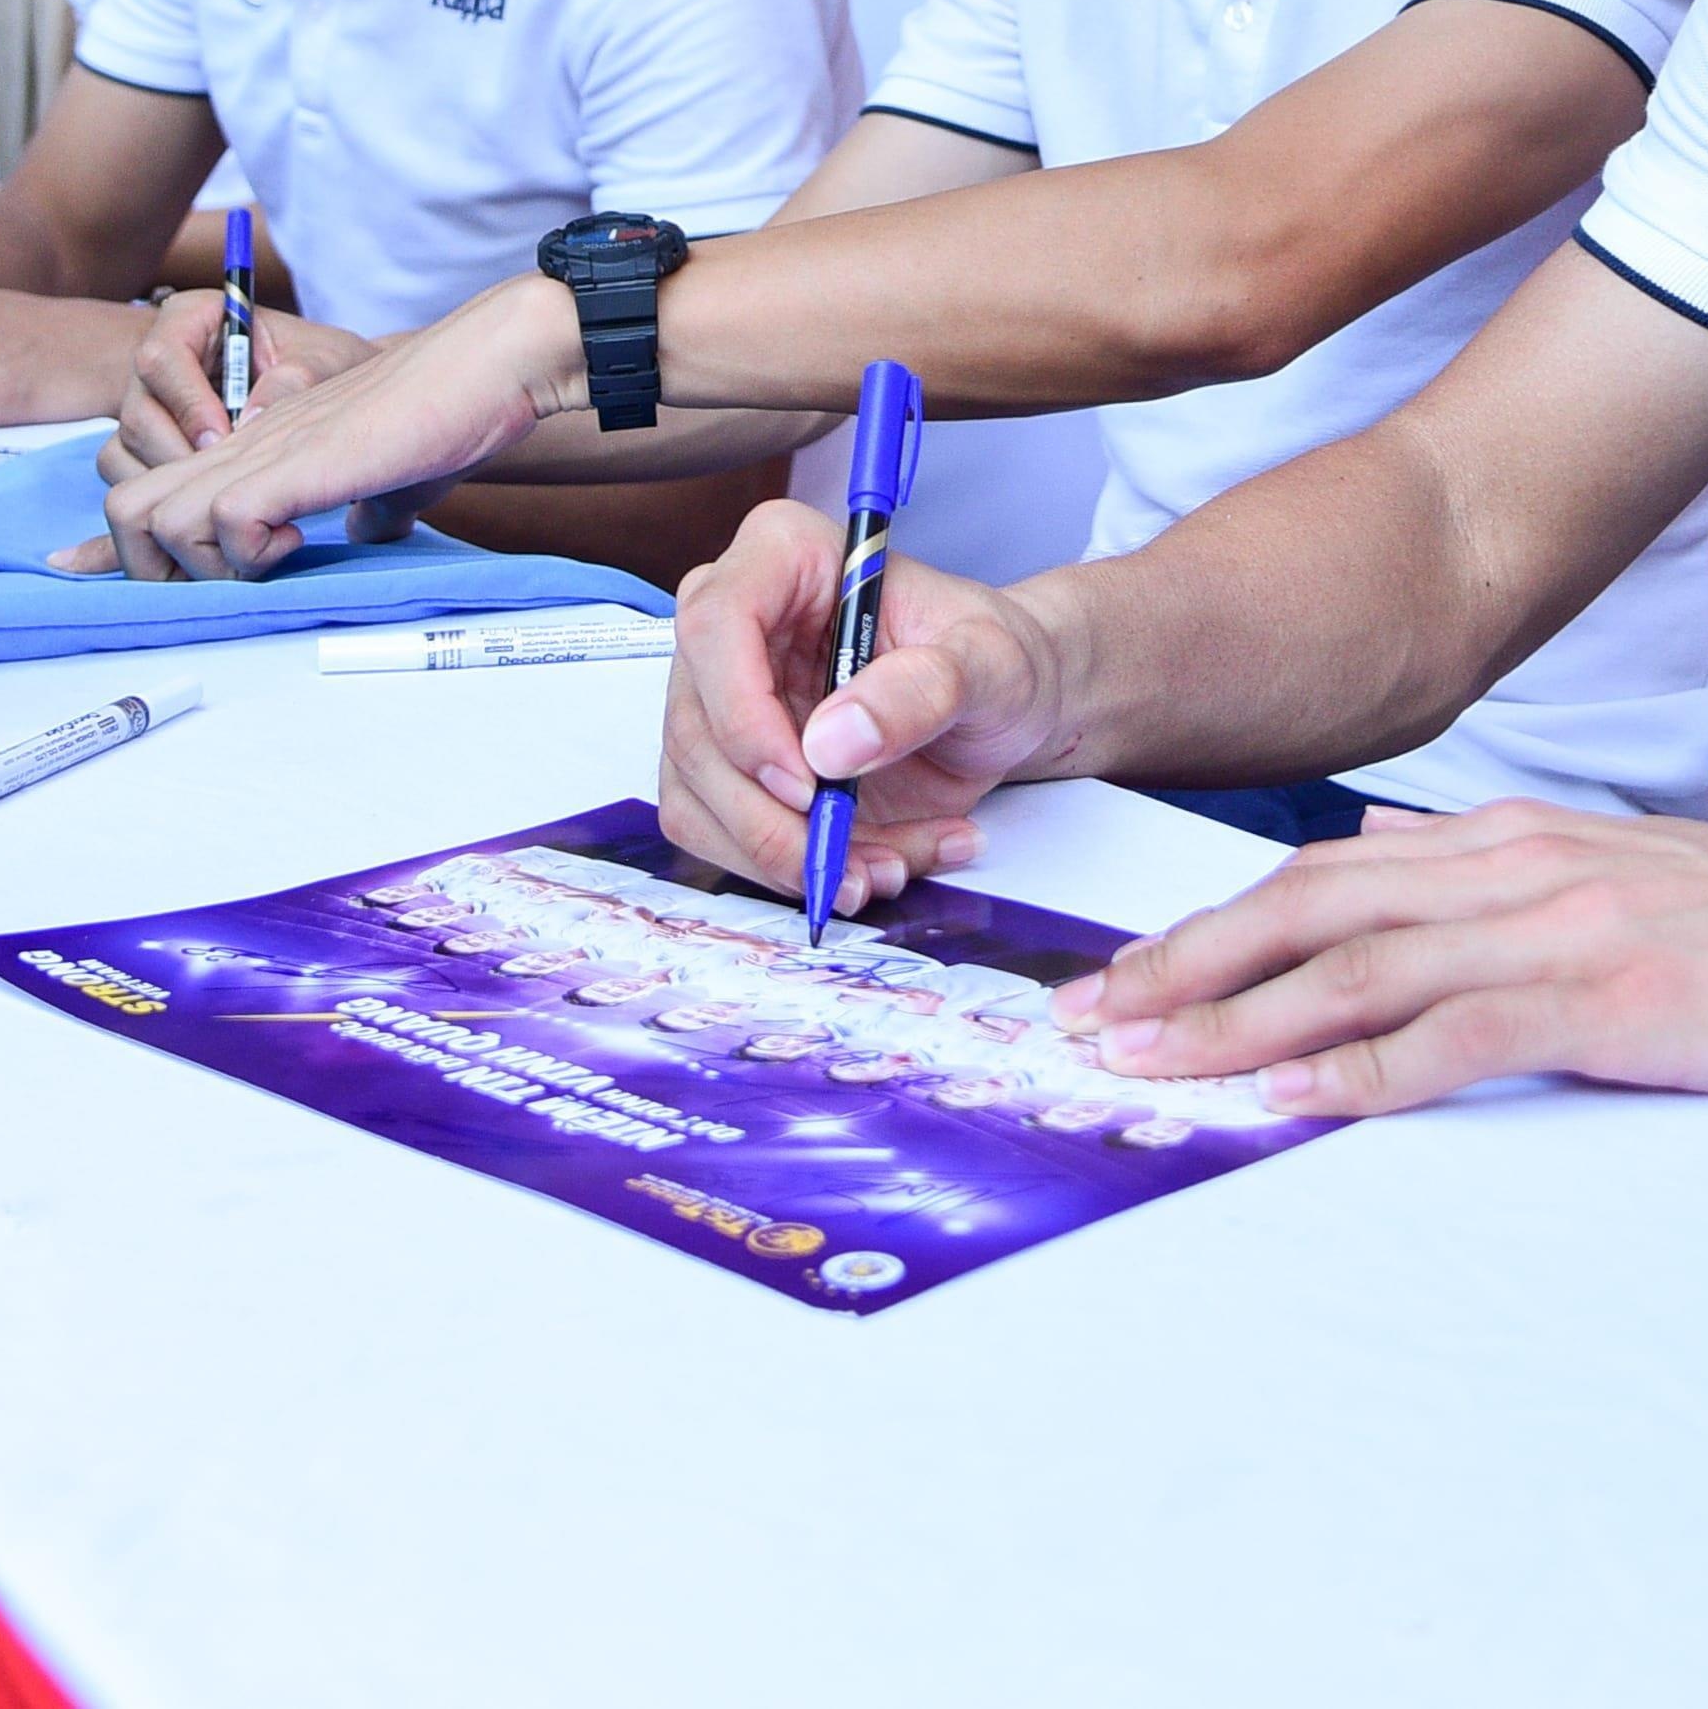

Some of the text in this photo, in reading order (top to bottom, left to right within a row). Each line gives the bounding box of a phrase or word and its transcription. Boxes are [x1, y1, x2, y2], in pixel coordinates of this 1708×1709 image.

[497, 651, 587, 667] DecoColor
[858, 612, 875, 660] MARKER
[18, 950, 168, 1015] STRONG
[77, 959, 172, 1000] VIETNAM
[335, 996, 502, 1054] QUANG
[443, 1065, 546, 1106] TIN
[479, 1045, 616, 1095] VINH
